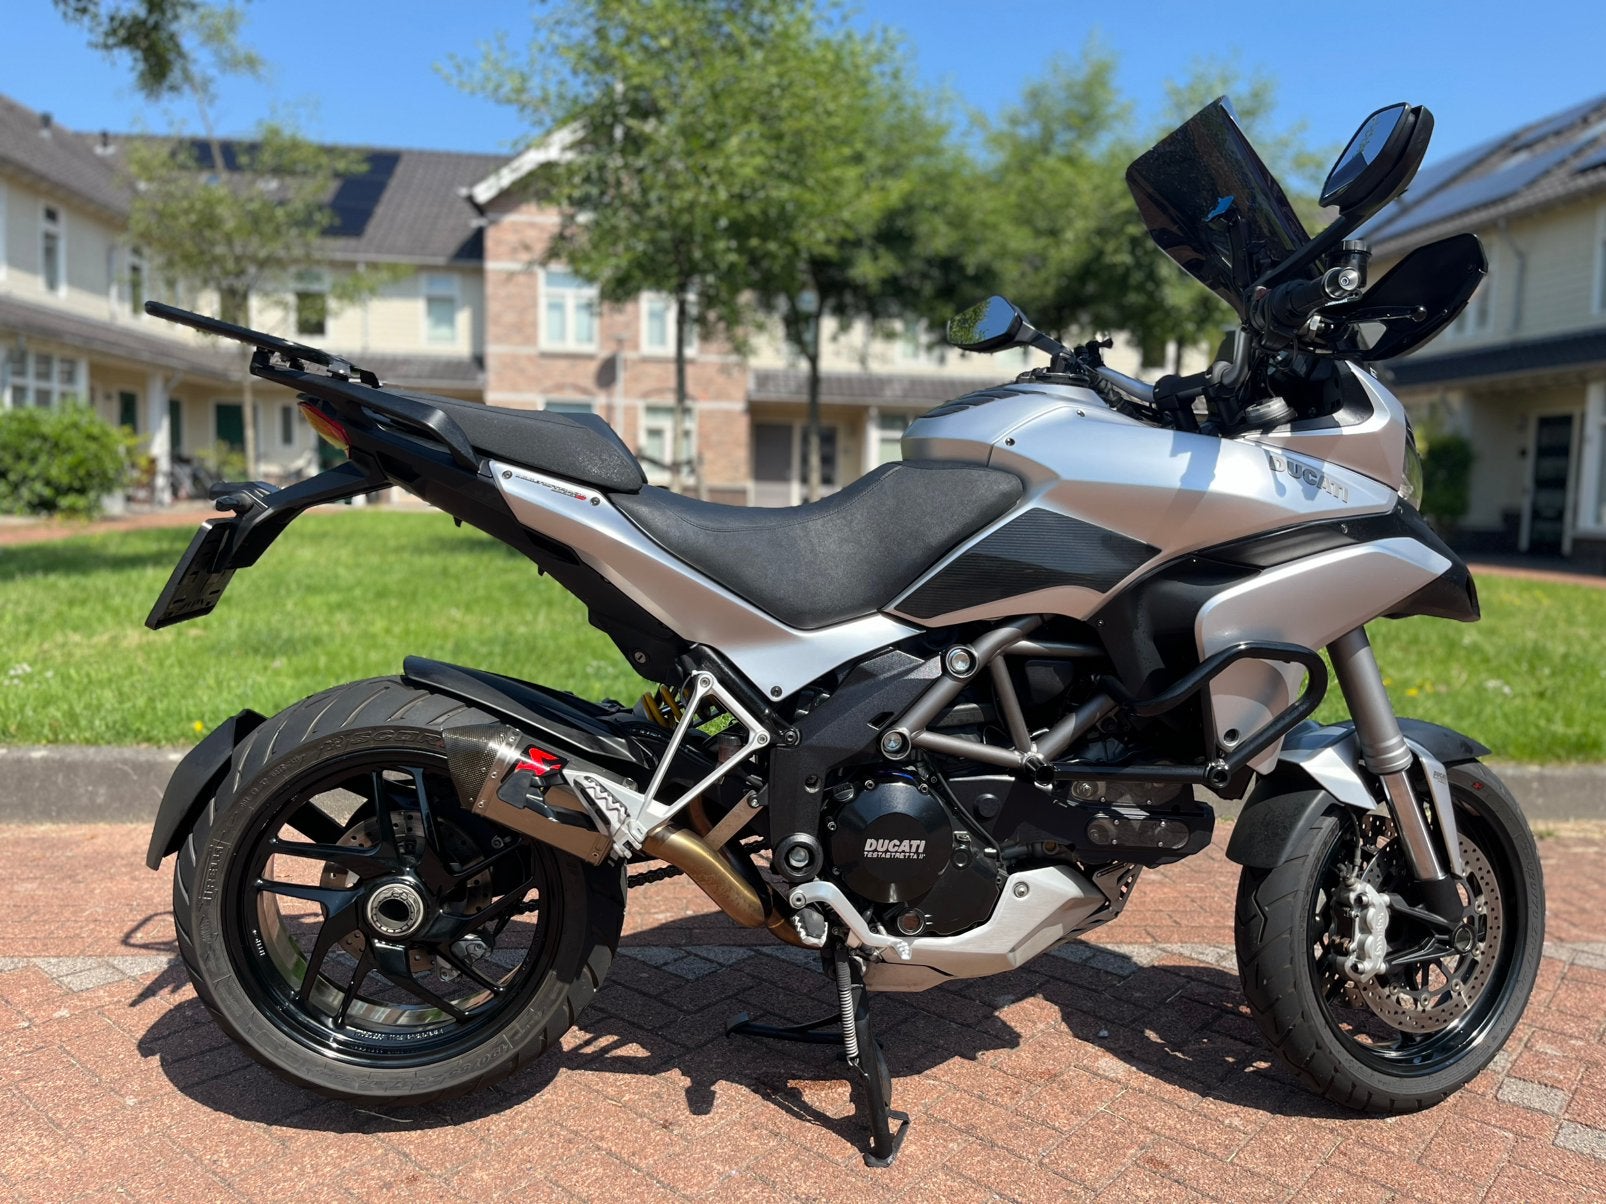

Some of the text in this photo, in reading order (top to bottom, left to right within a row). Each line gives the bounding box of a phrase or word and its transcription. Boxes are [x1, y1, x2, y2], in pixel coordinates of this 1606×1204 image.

[1268, 454, 1350, 504] DUCATI
[864, 838, 926, 853] DUCATI
[863, 851, 918, 859] TESTASTRETTA
